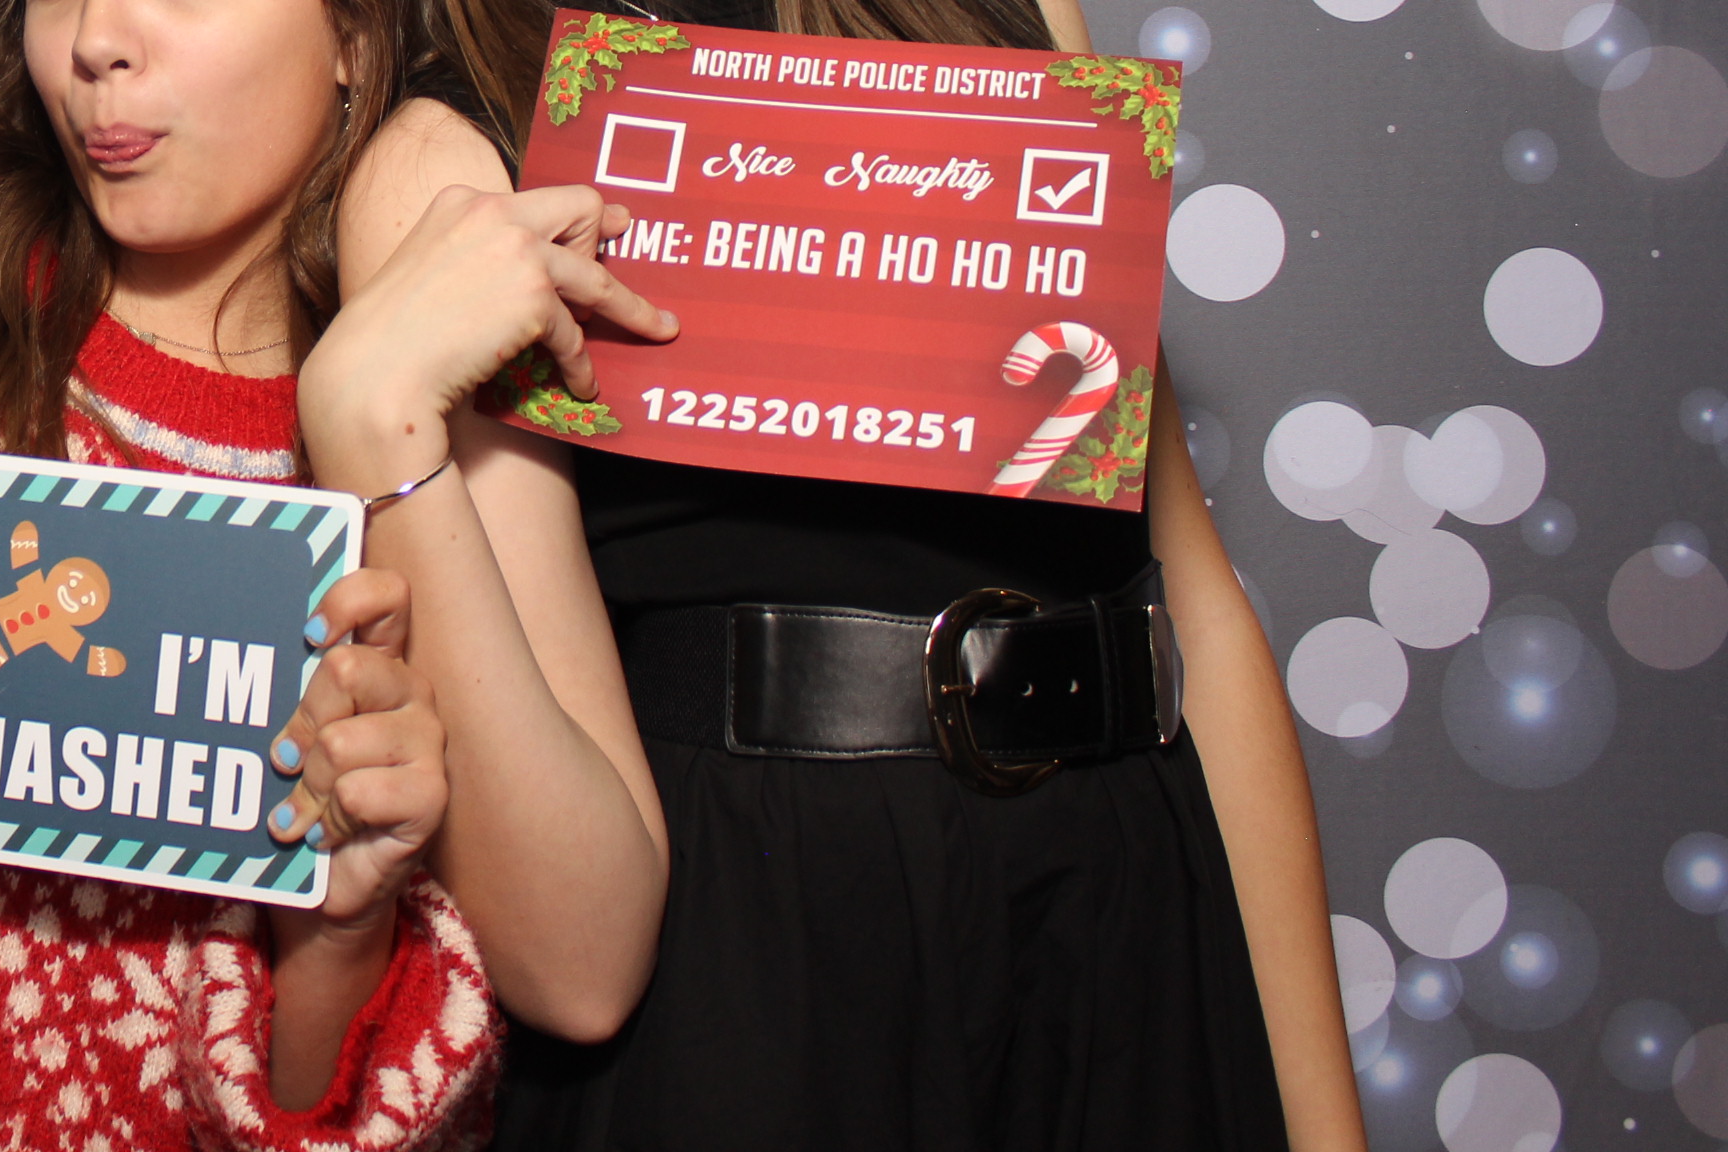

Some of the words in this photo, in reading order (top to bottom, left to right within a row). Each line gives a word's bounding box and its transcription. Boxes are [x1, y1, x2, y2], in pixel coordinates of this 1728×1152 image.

[691, 47, 773, 84] NORTH
[777, 55, 839, 88] POLE
[842, 60, 929, 93] POLICE
[933, 66, 1046, 100] DISTRICT
[701, 142, 797, 183] Nice
[823, 151, 995, 202] Naughty
[703, 220, 826, 276] BEING
[835, 231, 866, 279] A
[877, 233, 939, 285] HO
[950, 239, 1012, 291] HO
[1025, 245, 1087, 297] HO
[641, 387, 976, 452] 12252018251
